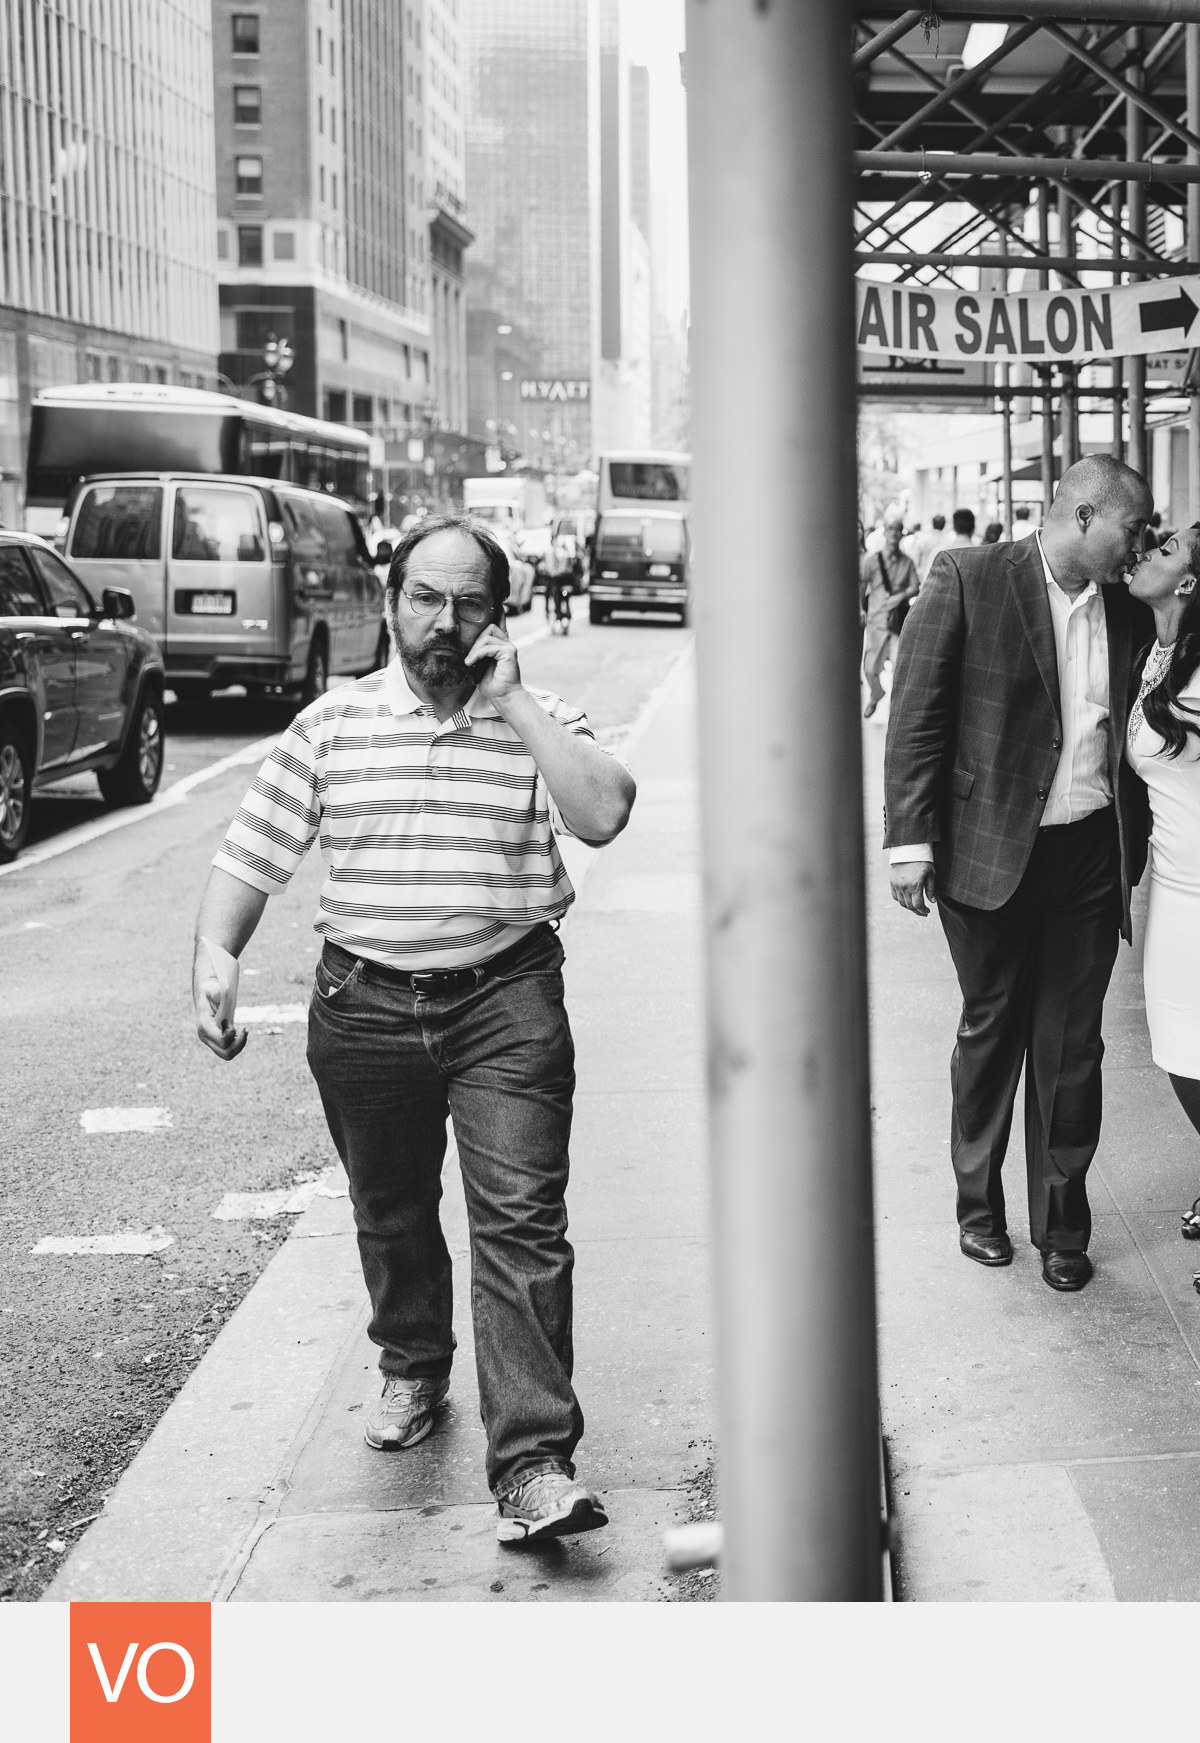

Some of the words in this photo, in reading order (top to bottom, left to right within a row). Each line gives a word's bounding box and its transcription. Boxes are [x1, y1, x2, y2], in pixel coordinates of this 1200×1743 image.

[857, 286, 939, 352] AIR
[955, 293, 1114, 355] SALON
[520, 379, 590, 402] HYATT
